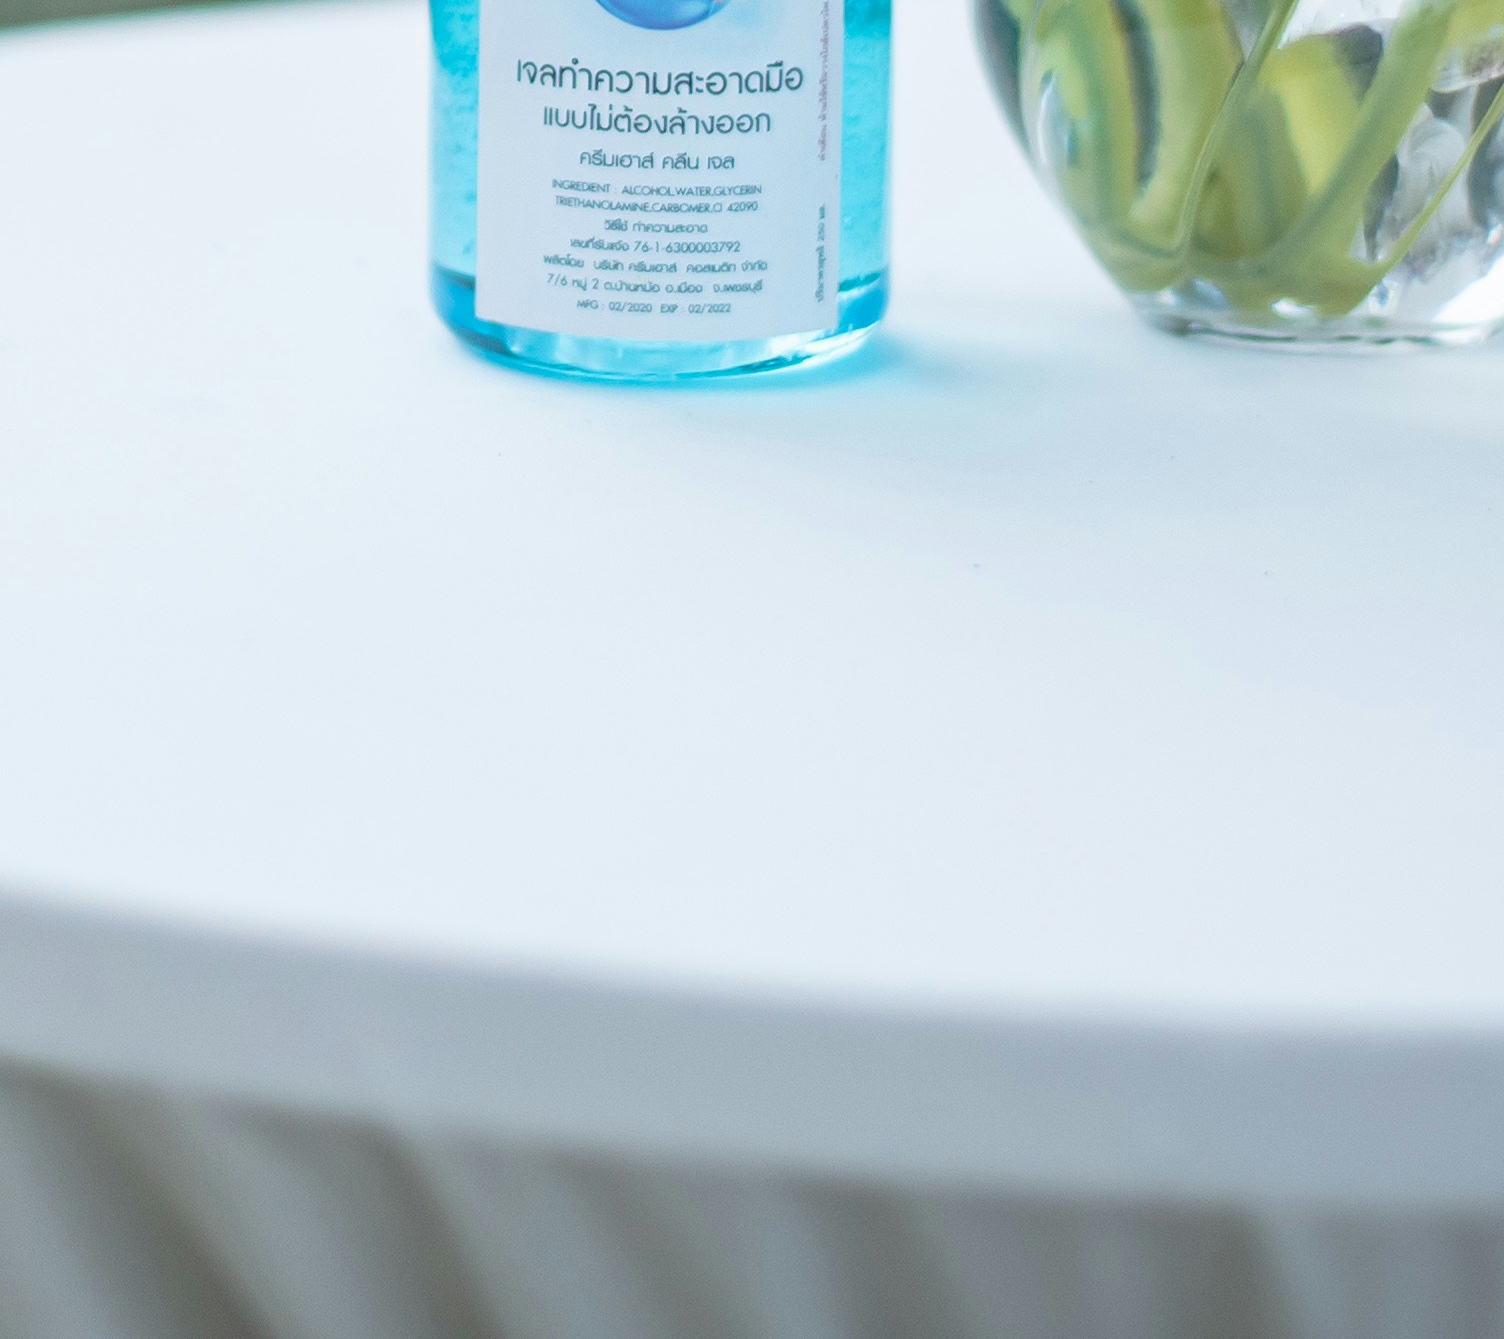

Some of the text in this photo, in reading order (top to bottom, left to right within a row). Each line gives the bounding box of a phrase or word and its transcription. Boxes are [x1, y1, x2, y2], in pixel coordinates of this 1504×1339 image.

[517, 58, 804, 96] เจลทำความสะอาดมือ
[543, 103, 772, 135] แบบไม่ต้องล้างออก
[579, 149, 735, 170] ครีมเฮาส์ คลีน เจล
[552, 178, 611, 194] INGREDIENT
[726, 201, 759, 213] 42090
[633, 240, 741, 254] 76-1-6300003792
[547, 273, 568, 287] 7/6
[609, 301, 653, 314] 02/2020
[688, 303, 732, 315] 02/2022
